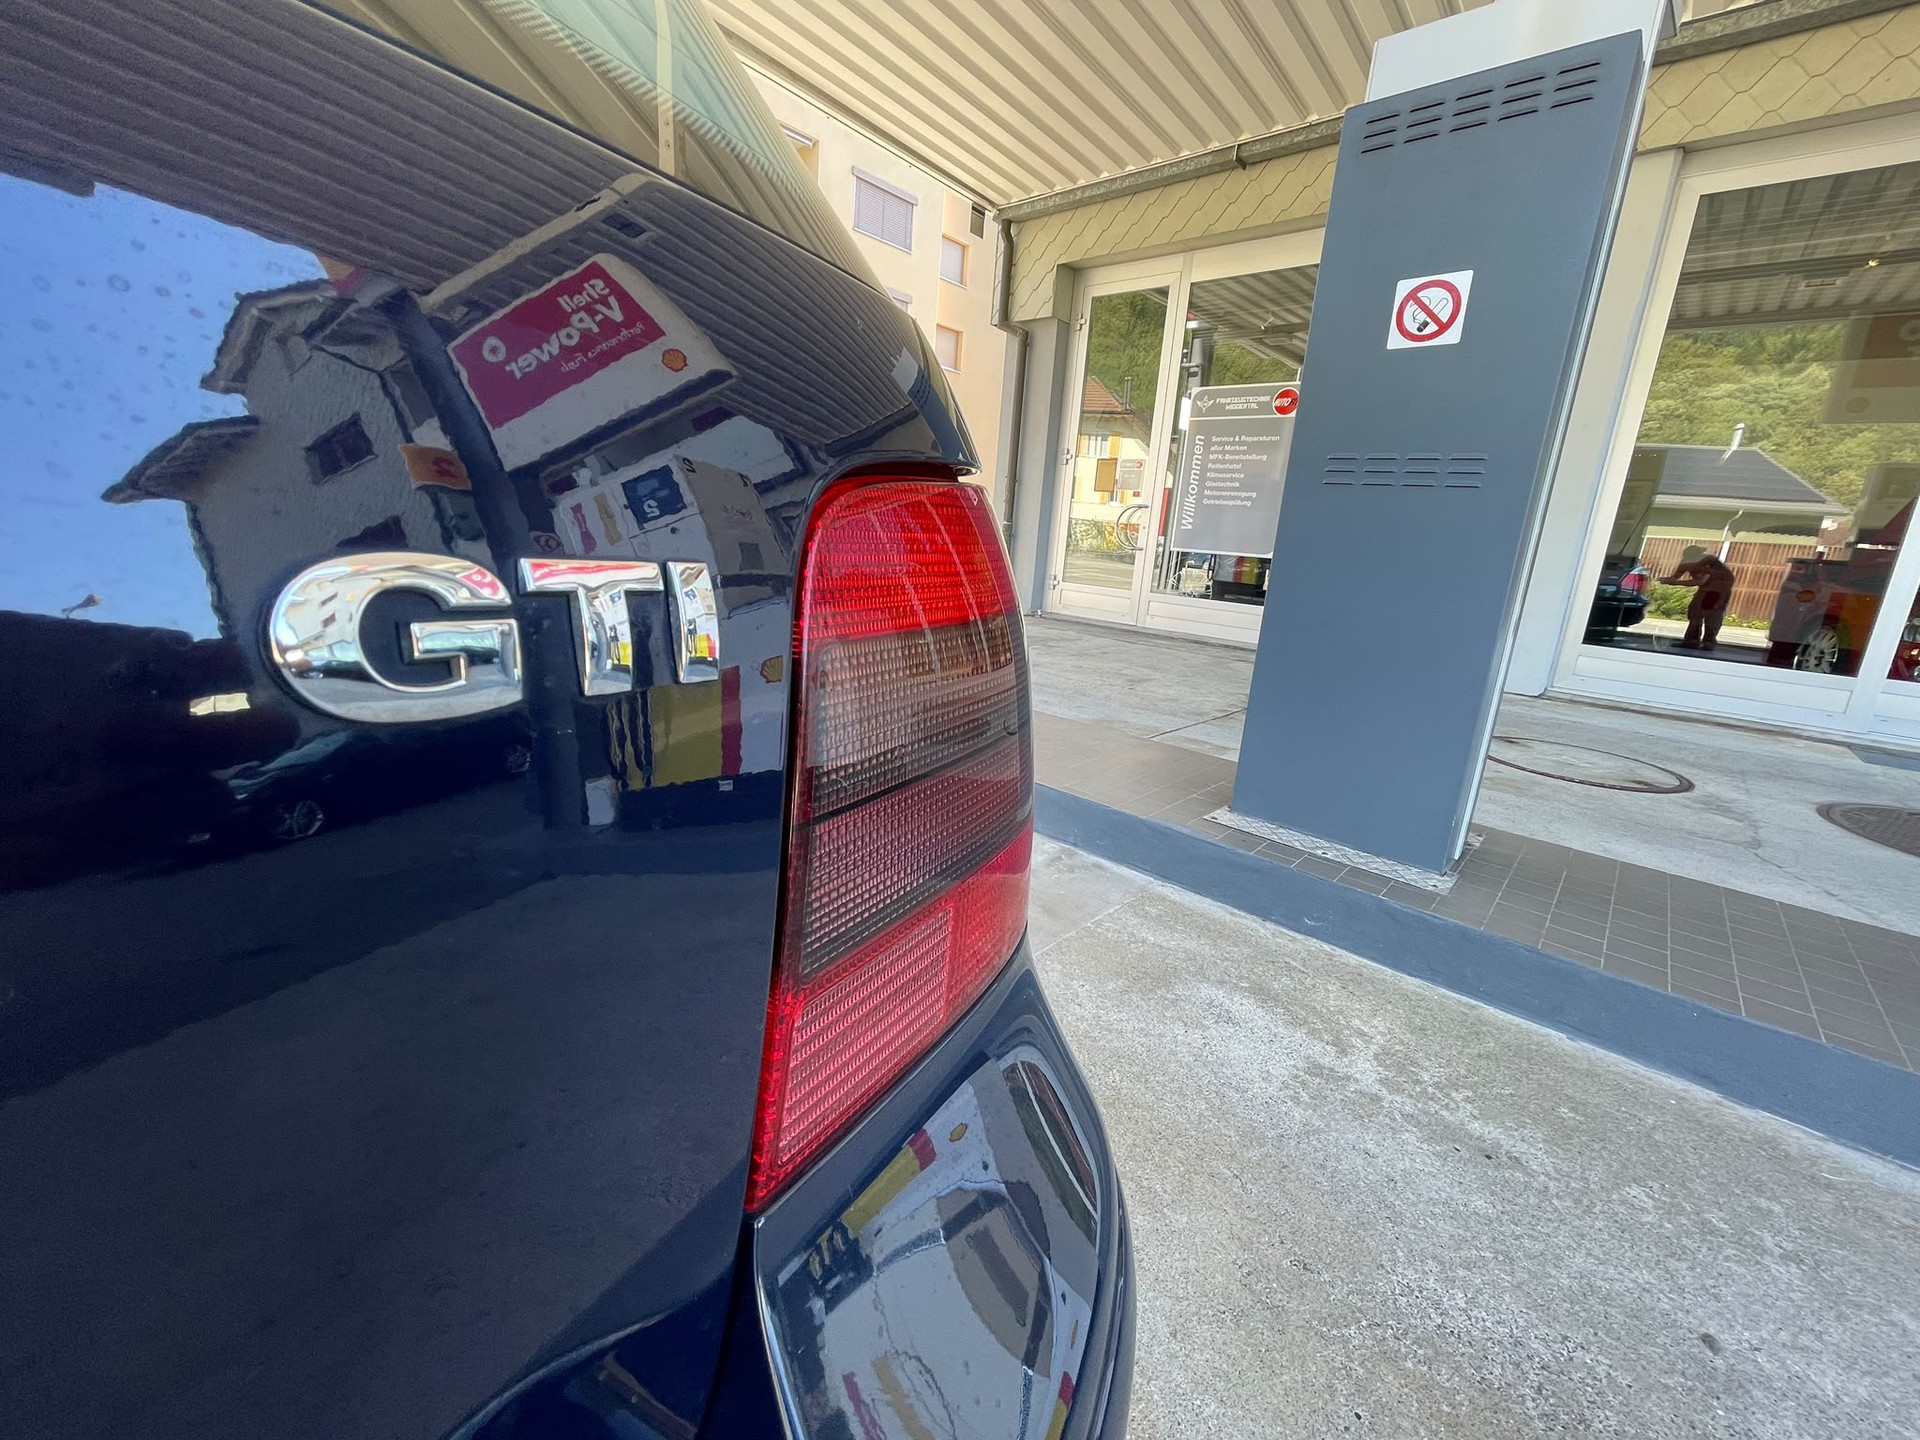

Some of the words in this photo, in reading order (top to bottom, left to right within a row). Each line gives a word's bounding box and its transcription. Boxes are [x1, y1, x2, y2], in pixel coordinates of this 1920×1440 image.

[1240, 435, 1280, 443] Reparaturen
[1206, 471, 1245, 479] Klimaservice
[1180, 434, 1205, 530] Willkommen
[1203, 489, 1257, 498] Motorenreinigung
[1202, 498, 1252, 507] Getriebespülung
[268, 551, 721, 724] GTI
